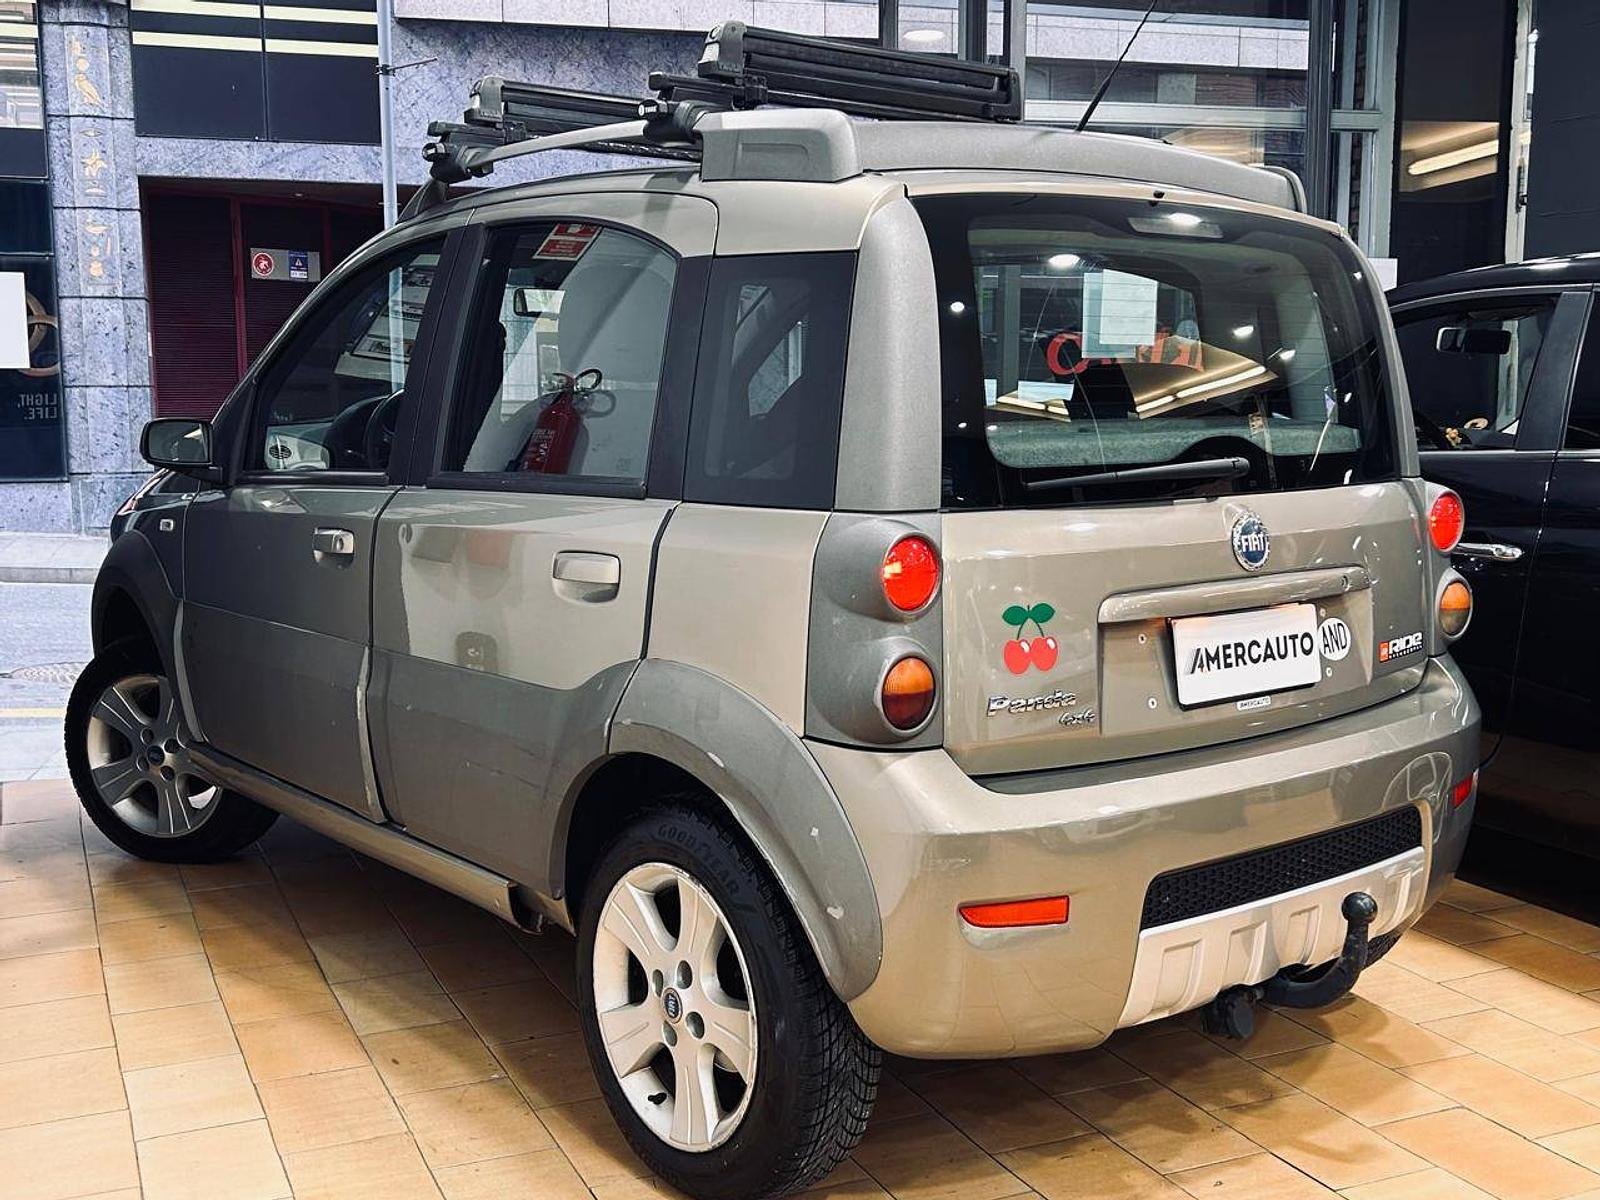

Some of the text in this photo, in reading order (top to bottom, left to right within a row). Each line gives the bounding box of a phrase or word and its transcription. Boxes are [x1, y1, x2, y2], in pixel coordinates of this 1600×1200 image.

[1241, 532, 1264, 552] FIAT
[1185, 631, 1314, 675] AMERCAUTO
[1324, 622, 1348, 655] AND
[987, 690, 1077, 717] Panda
